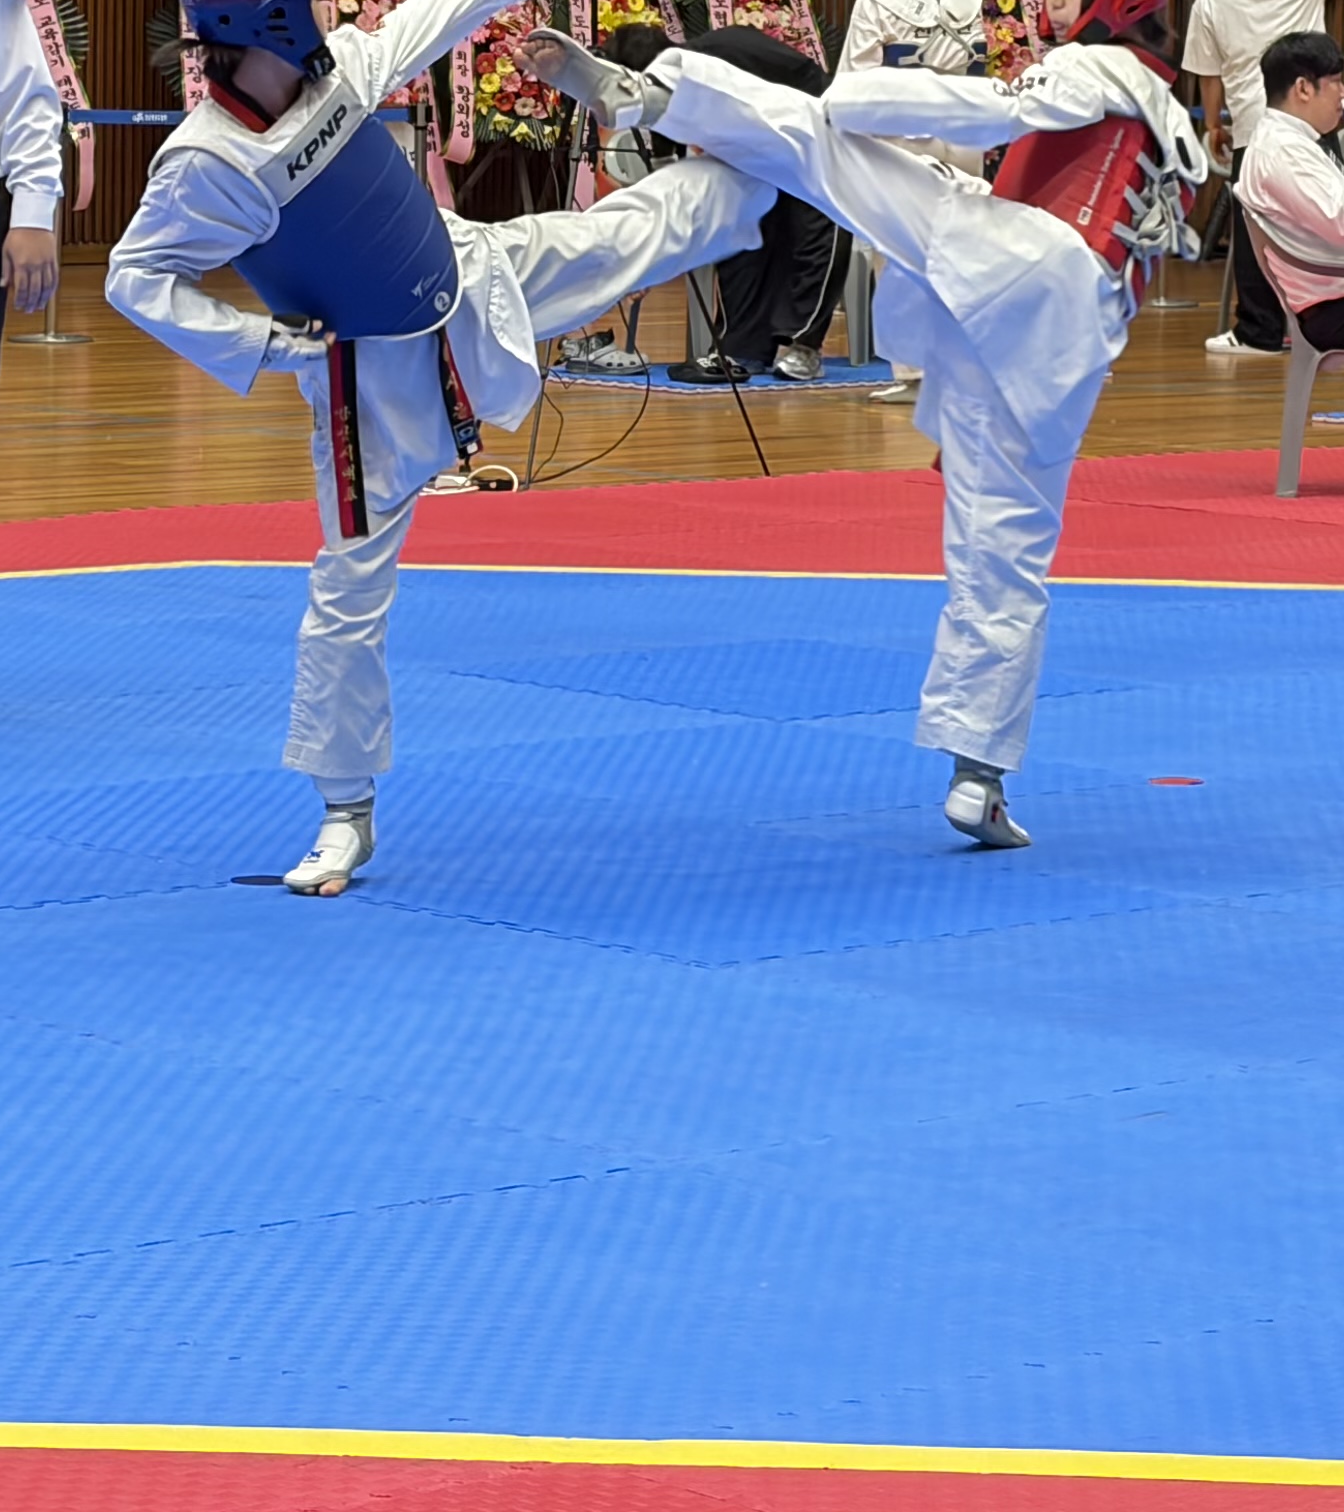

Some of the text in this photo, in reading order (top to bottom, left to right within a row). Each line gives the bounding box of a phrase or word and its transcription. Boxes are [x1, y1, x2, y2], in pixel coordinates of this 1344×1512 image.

[456, 50, 470, 78] 회장
[286, 103, 348, 182] KPNP
[436, 293, 449, 310] 2
